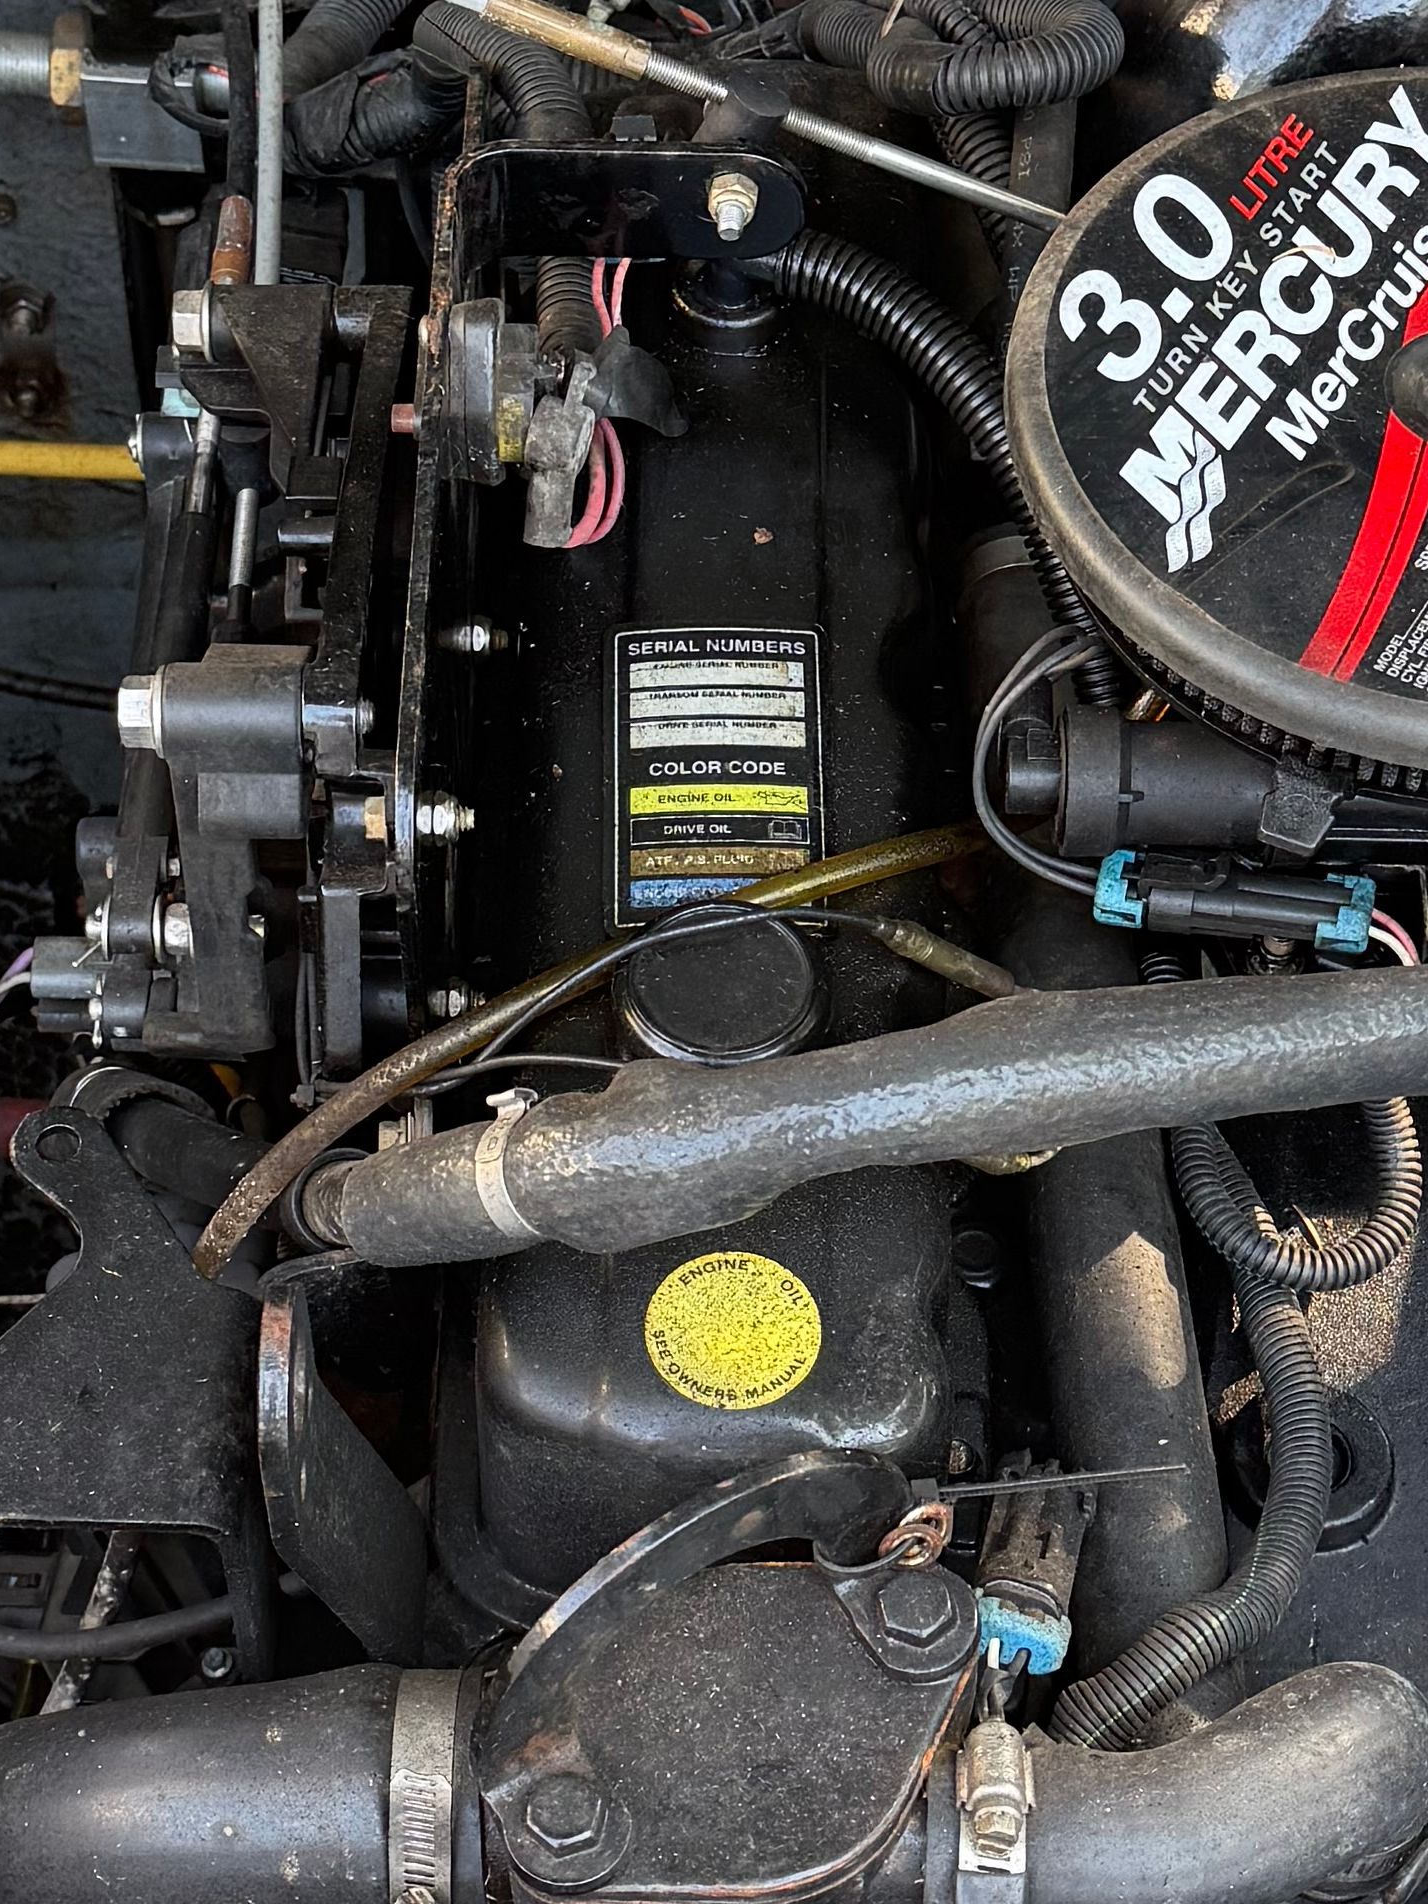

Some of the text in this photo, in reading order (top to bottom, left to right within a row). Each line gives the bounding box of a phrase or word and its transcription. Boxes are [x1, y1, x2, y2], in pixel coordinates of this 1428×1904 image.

[1058, 113, 1313, 381] 3.0 LITRE
[1132, 141, 1336, 411] TURN KEY START
[628, 638, 806, 656] SERIAL NUMBERS
[1373, 634, 1406, 671] MODEL
[649, 761, 786, 777] COLOR CODE
[658, 793, 736, 804] ENGINE OIL
[664, 824, 732, 835] DRIVE OIL
[678, 1258, 804, 1307] ENGINE OIL
[653, 1329, 807, 1402] SEE OWNERS MANUAL
